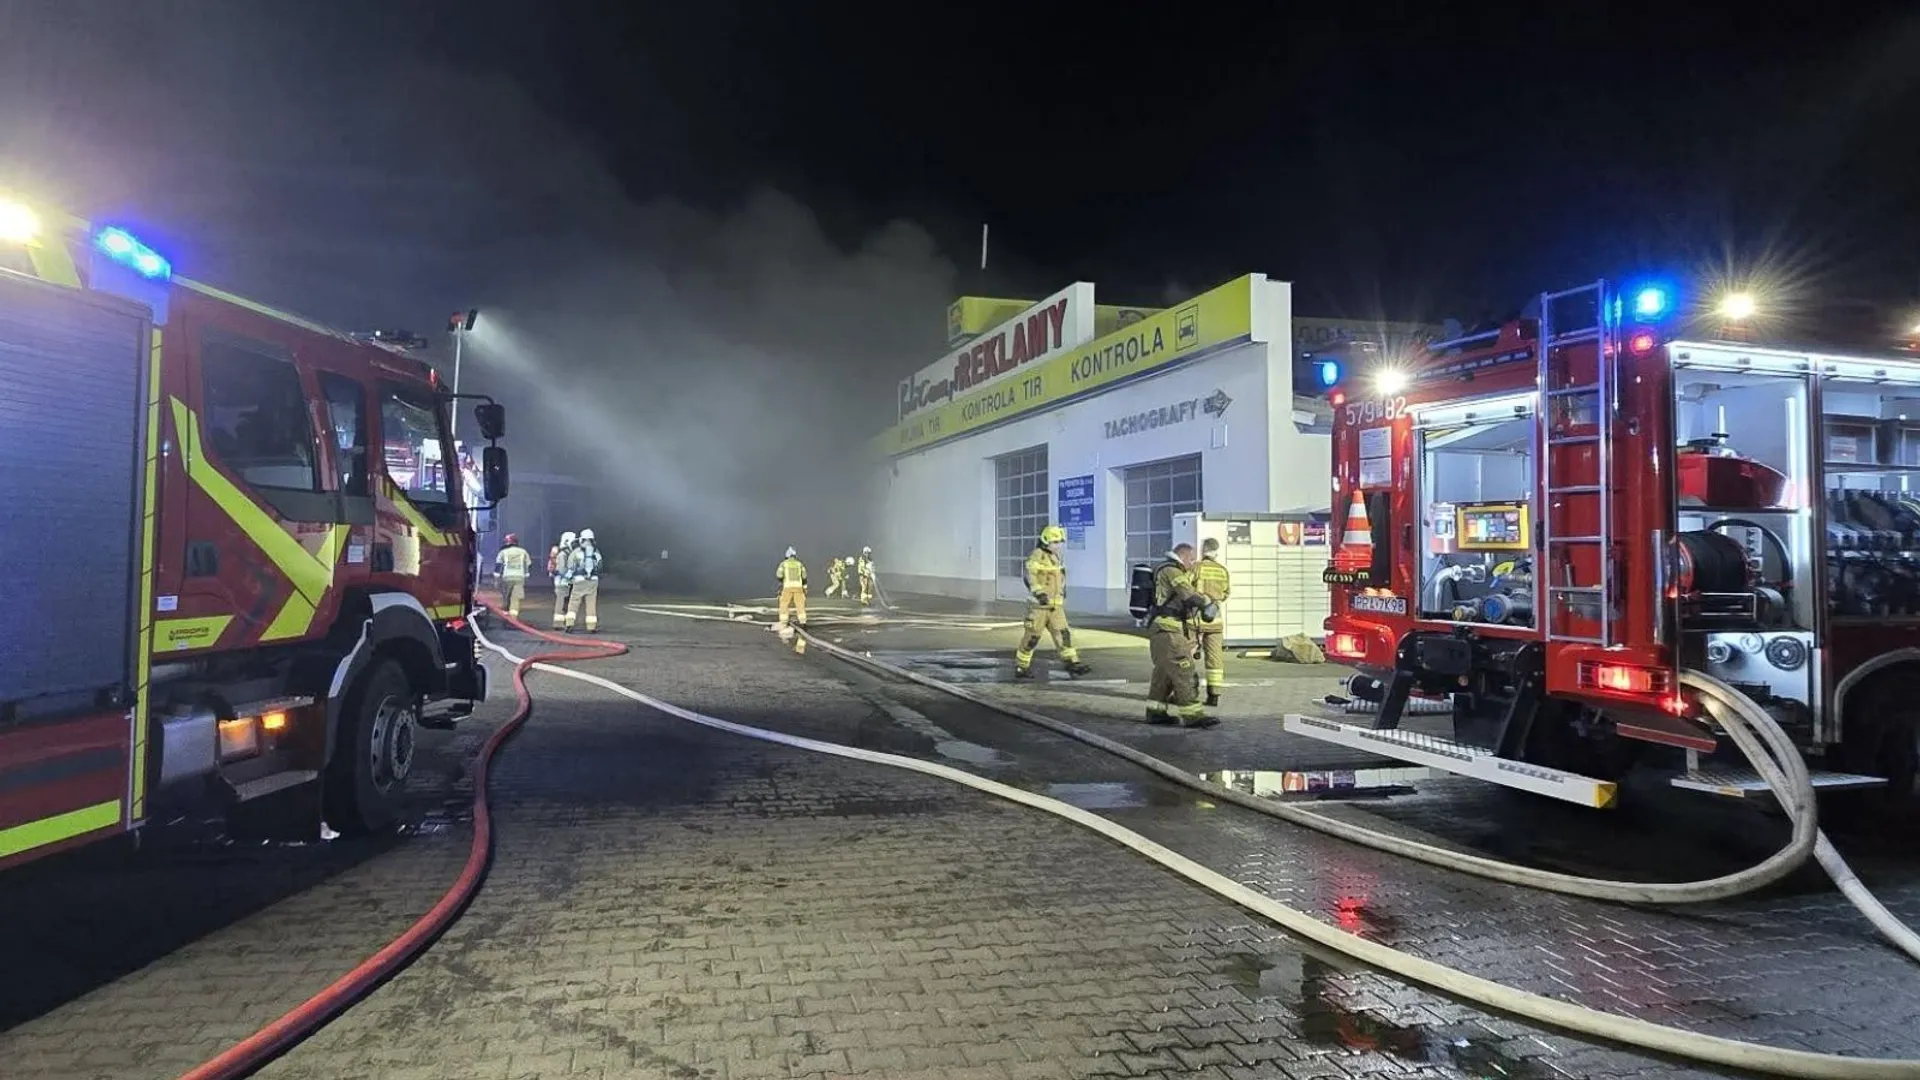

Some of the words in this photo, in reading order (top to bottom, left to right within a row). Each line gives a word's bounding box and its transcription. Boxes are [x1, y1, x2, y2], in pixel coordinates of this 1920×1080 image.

[955, 298, 1068, 392] REKLAMY
[961, 387, 1016, 422] KONTROLA
[1022, 376, 1042, 400] TIR
[1071, 327, 1165, 383] KONTROLA
[1104, 399, 1198, 439] TACHOGRAFY
